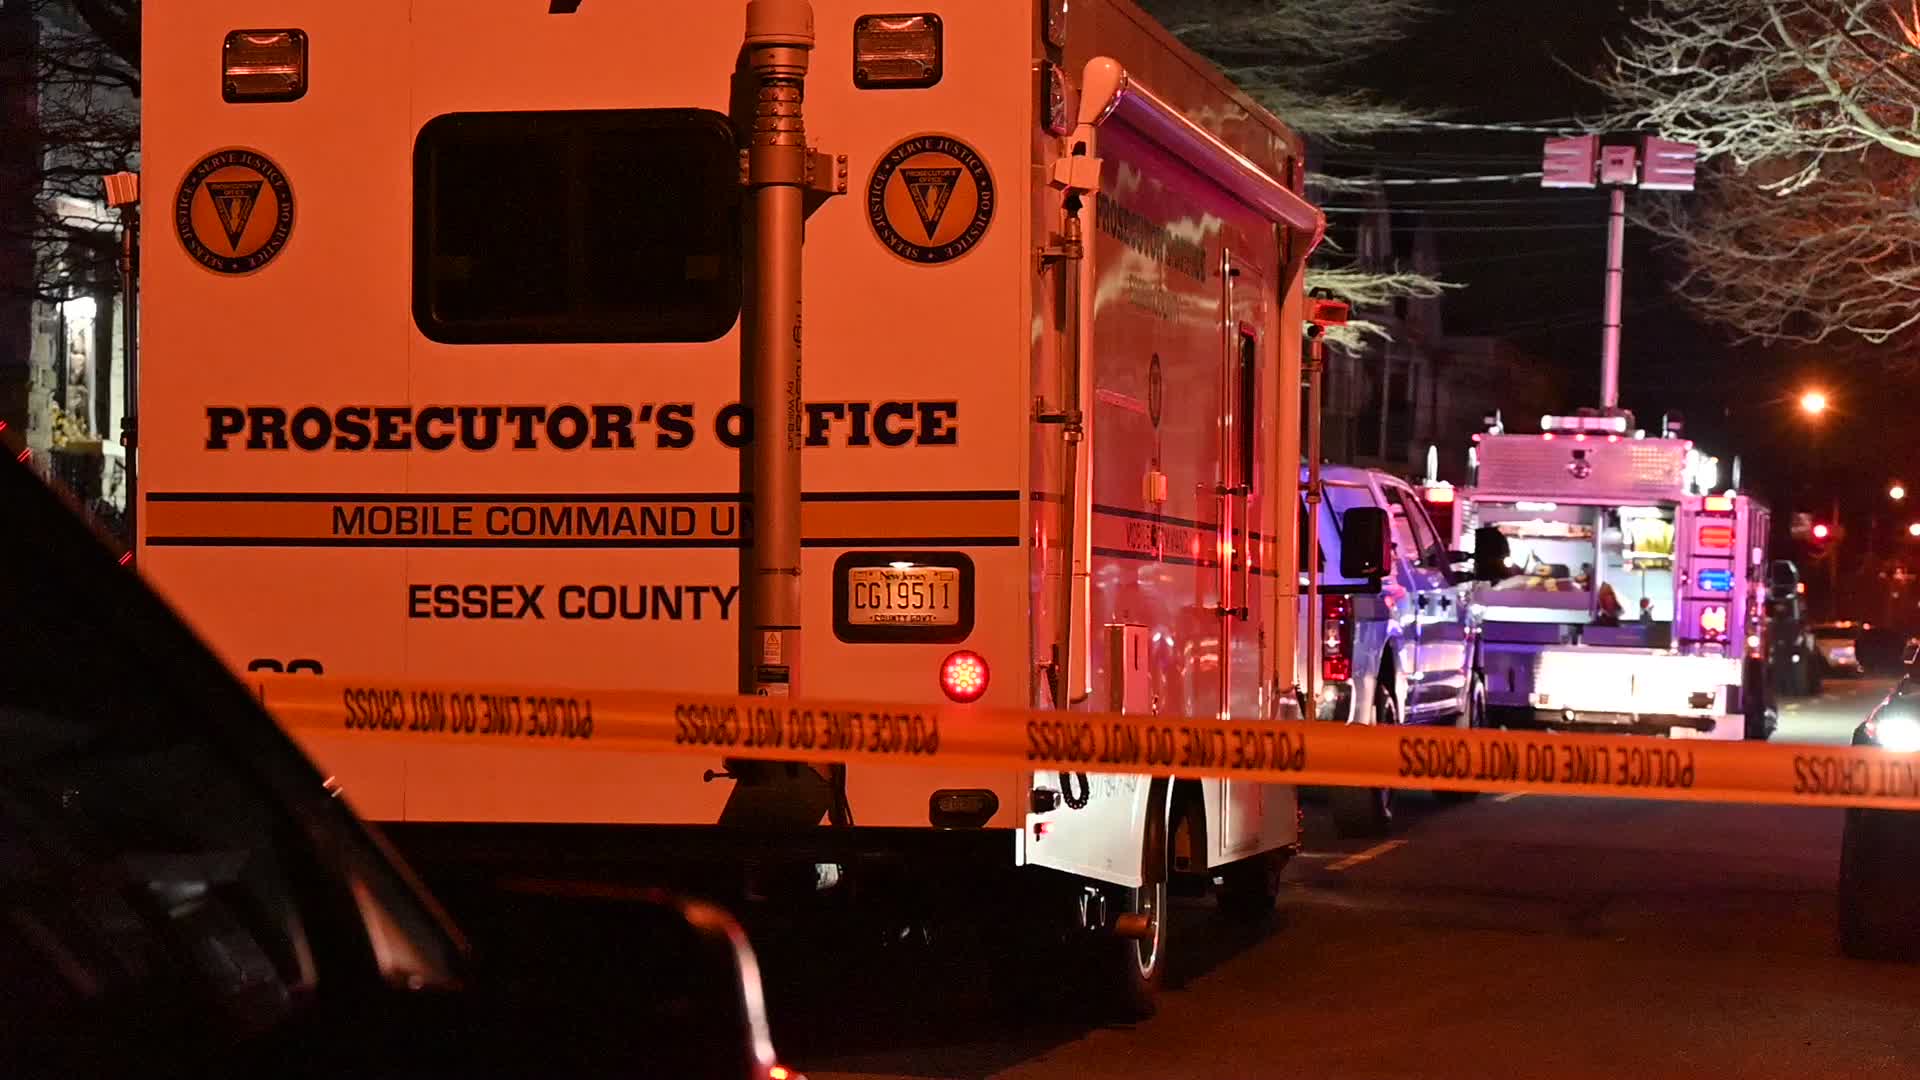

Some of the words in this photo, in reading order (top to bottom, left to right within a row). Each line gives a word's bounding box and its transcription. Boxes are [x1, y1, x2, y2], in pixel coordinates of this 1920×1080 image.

[890, 139, 933, 162] SERVE
[937, 140, 984, 177] JUSTICE
[871, 173, 889, 227] JUSTICE
[981, 191, 992, 211] DO
[944, 212, 989, 257] JUSTICE
[206, 404, 695, 450] PROSECUTOR'S
[715, 402, 957, 448] OFICE
[332, 505, 473, 536] MOBILE
[486, 506, 697, 537] COMMAND
[408, 584, 545, 619] ESSEX
[558, 585, 739, 620] COUNTY
[855, 582, 949, 609] CG19511
[343, 688, 402, 731] CROSS
[410, 691, 445, 733] NOT
[451, 693, 476, 734] DO
[480, 695, 521, 737] LINE
[527, 697, 594, 739] POLICE
[674, 704, 741, 746] CROSS
[744, 706, 784, 748] NOT
[788, 708, 816, 749] DO
[820, 711, 865, 752] LINE
[868, 713, 940, 755] POLICE
[1026, 721, 1095, 762] CROSS
[1100, 725, 1139, 764] NOT
[1146, 727, 1175, 766] DO
[1181, 727, 1226, 769] LINE
[1232, 729, 1306, 771] POLICE
[1399, 738, 1471, 778] CROSS
[1475, 741, 1519, 781] NOT
[1527, 743, 1555, 783] DO
[1561, 745, 1610, 785] LINE
[1616, 747, 1695, 787] POLICE
[1792, 755, 1870, 796] CROSS
[1876, 760, 1920, 797] NOT
